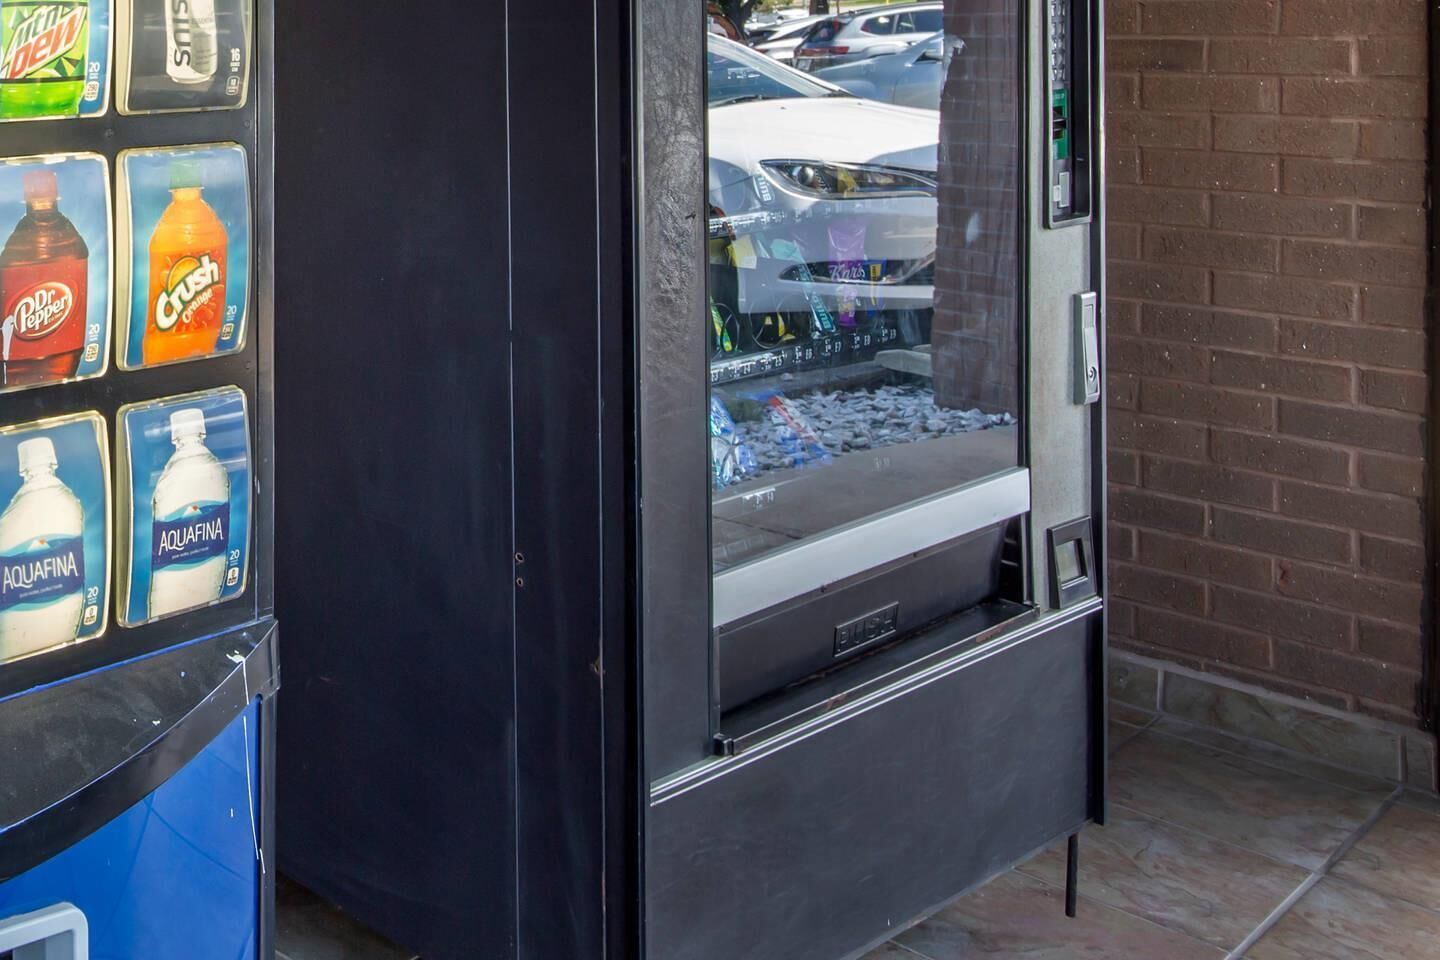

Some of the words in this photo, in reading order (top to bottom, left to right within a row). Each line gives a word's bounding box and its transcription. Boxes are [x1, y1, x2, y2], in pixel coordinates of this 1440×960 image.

[230, 48, 240, 62] 16
[88, 62, 100, 73] 20
[34, 289, 56, 312] Dr
[155, 254, 219, 330] Crush
[20, 296, 68, 333] Pepper
[182, 288, 213, 324] Orange
[226, 305, 237, 316] 20
[88, 323, 100, 335] 20
[158, 517, 223, 556] AQUAFINA
[229, 549, 240, 561] 20
[2, 551, 78, 594] AQUAFINA
[87, 586, 98, 599] 20
[837, 607, 895, 652] PUSH
